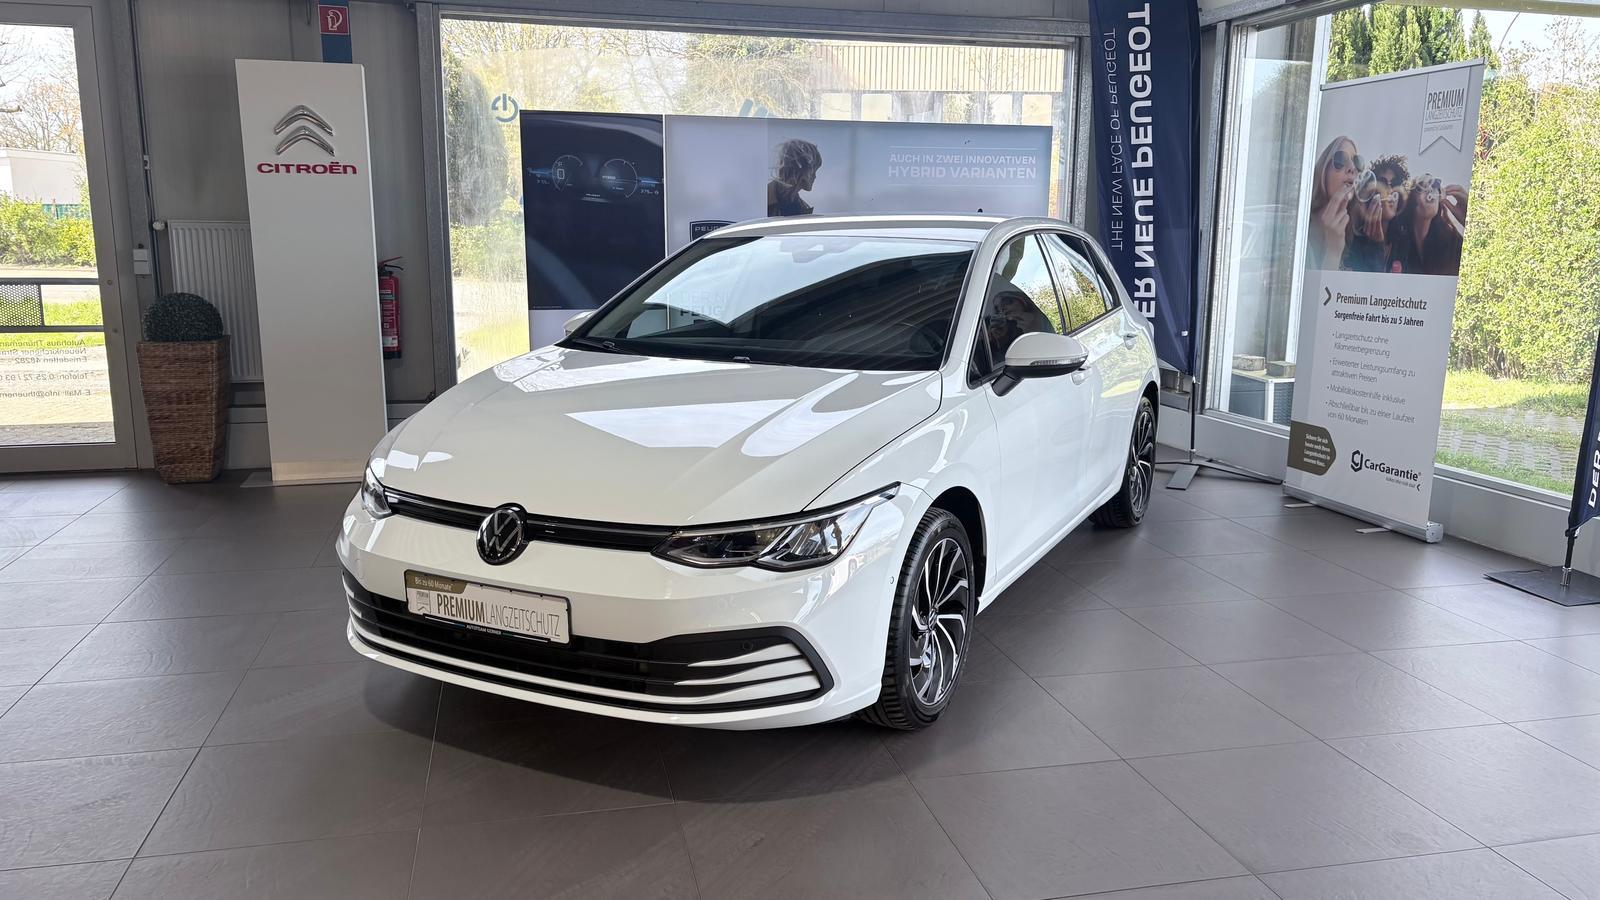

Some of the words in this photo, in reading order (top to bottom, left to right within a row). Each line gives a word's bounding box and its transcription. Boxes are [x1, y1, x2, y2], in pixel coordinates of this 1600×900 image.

[1426, 87, 1465, 111] PREMIUM
[889, 154, 920, 163] AUCH
[922, 154, 934, 164] IN
[936, 154, 963, 164] ZWEI
[965, 155, 1036, 165] INNOVATIVEN
[256, 161, 358, 175] CITROËN
[888, 165, 946, 178] HYBRID
[947, 166, 1037, 179] VARIANTEN
[694, 225, 720, 233] PEUG
[1336, 292, 1368, 306] Premium
[1369, 294, 1428, 310] Langzeitschutz
[1334, 310, 1364, 321] Sorgenfreie
[1365, 312, 1381, 323] Fahrt
[1381, 314, 1390, 324] bis
[1390, 317, 1398, 325] zu
[1398, 316, 1403, 325] 5
[1403, 316, 1424, 327] Jahren
[1335, 331, 1374, 342] Langzeitschutz
[1374, 336, 1389, 345] ohne
[1334, 342, 1391, 357] Kilometerbegrenzung
[1332, 359, 1359, 369] Erweiterter
[1360, 362, 1407, 377] Leistungsumfang
[1407, 370, 1416, 378] zu
[1331, 370, 1358, 380] attraktiven
[1358, 373, 1378, 383] Preisen
[1381, 394, 1406, 405] inklusive
[1337, 412, 1345, 420] 60
[1345, 414, 1369, 426] Monaten
[1360, 405, 1369, 415] bis
[1377, 410, 1391, 419] einer
[1392, 411, 1415, 424] Laufzeit
